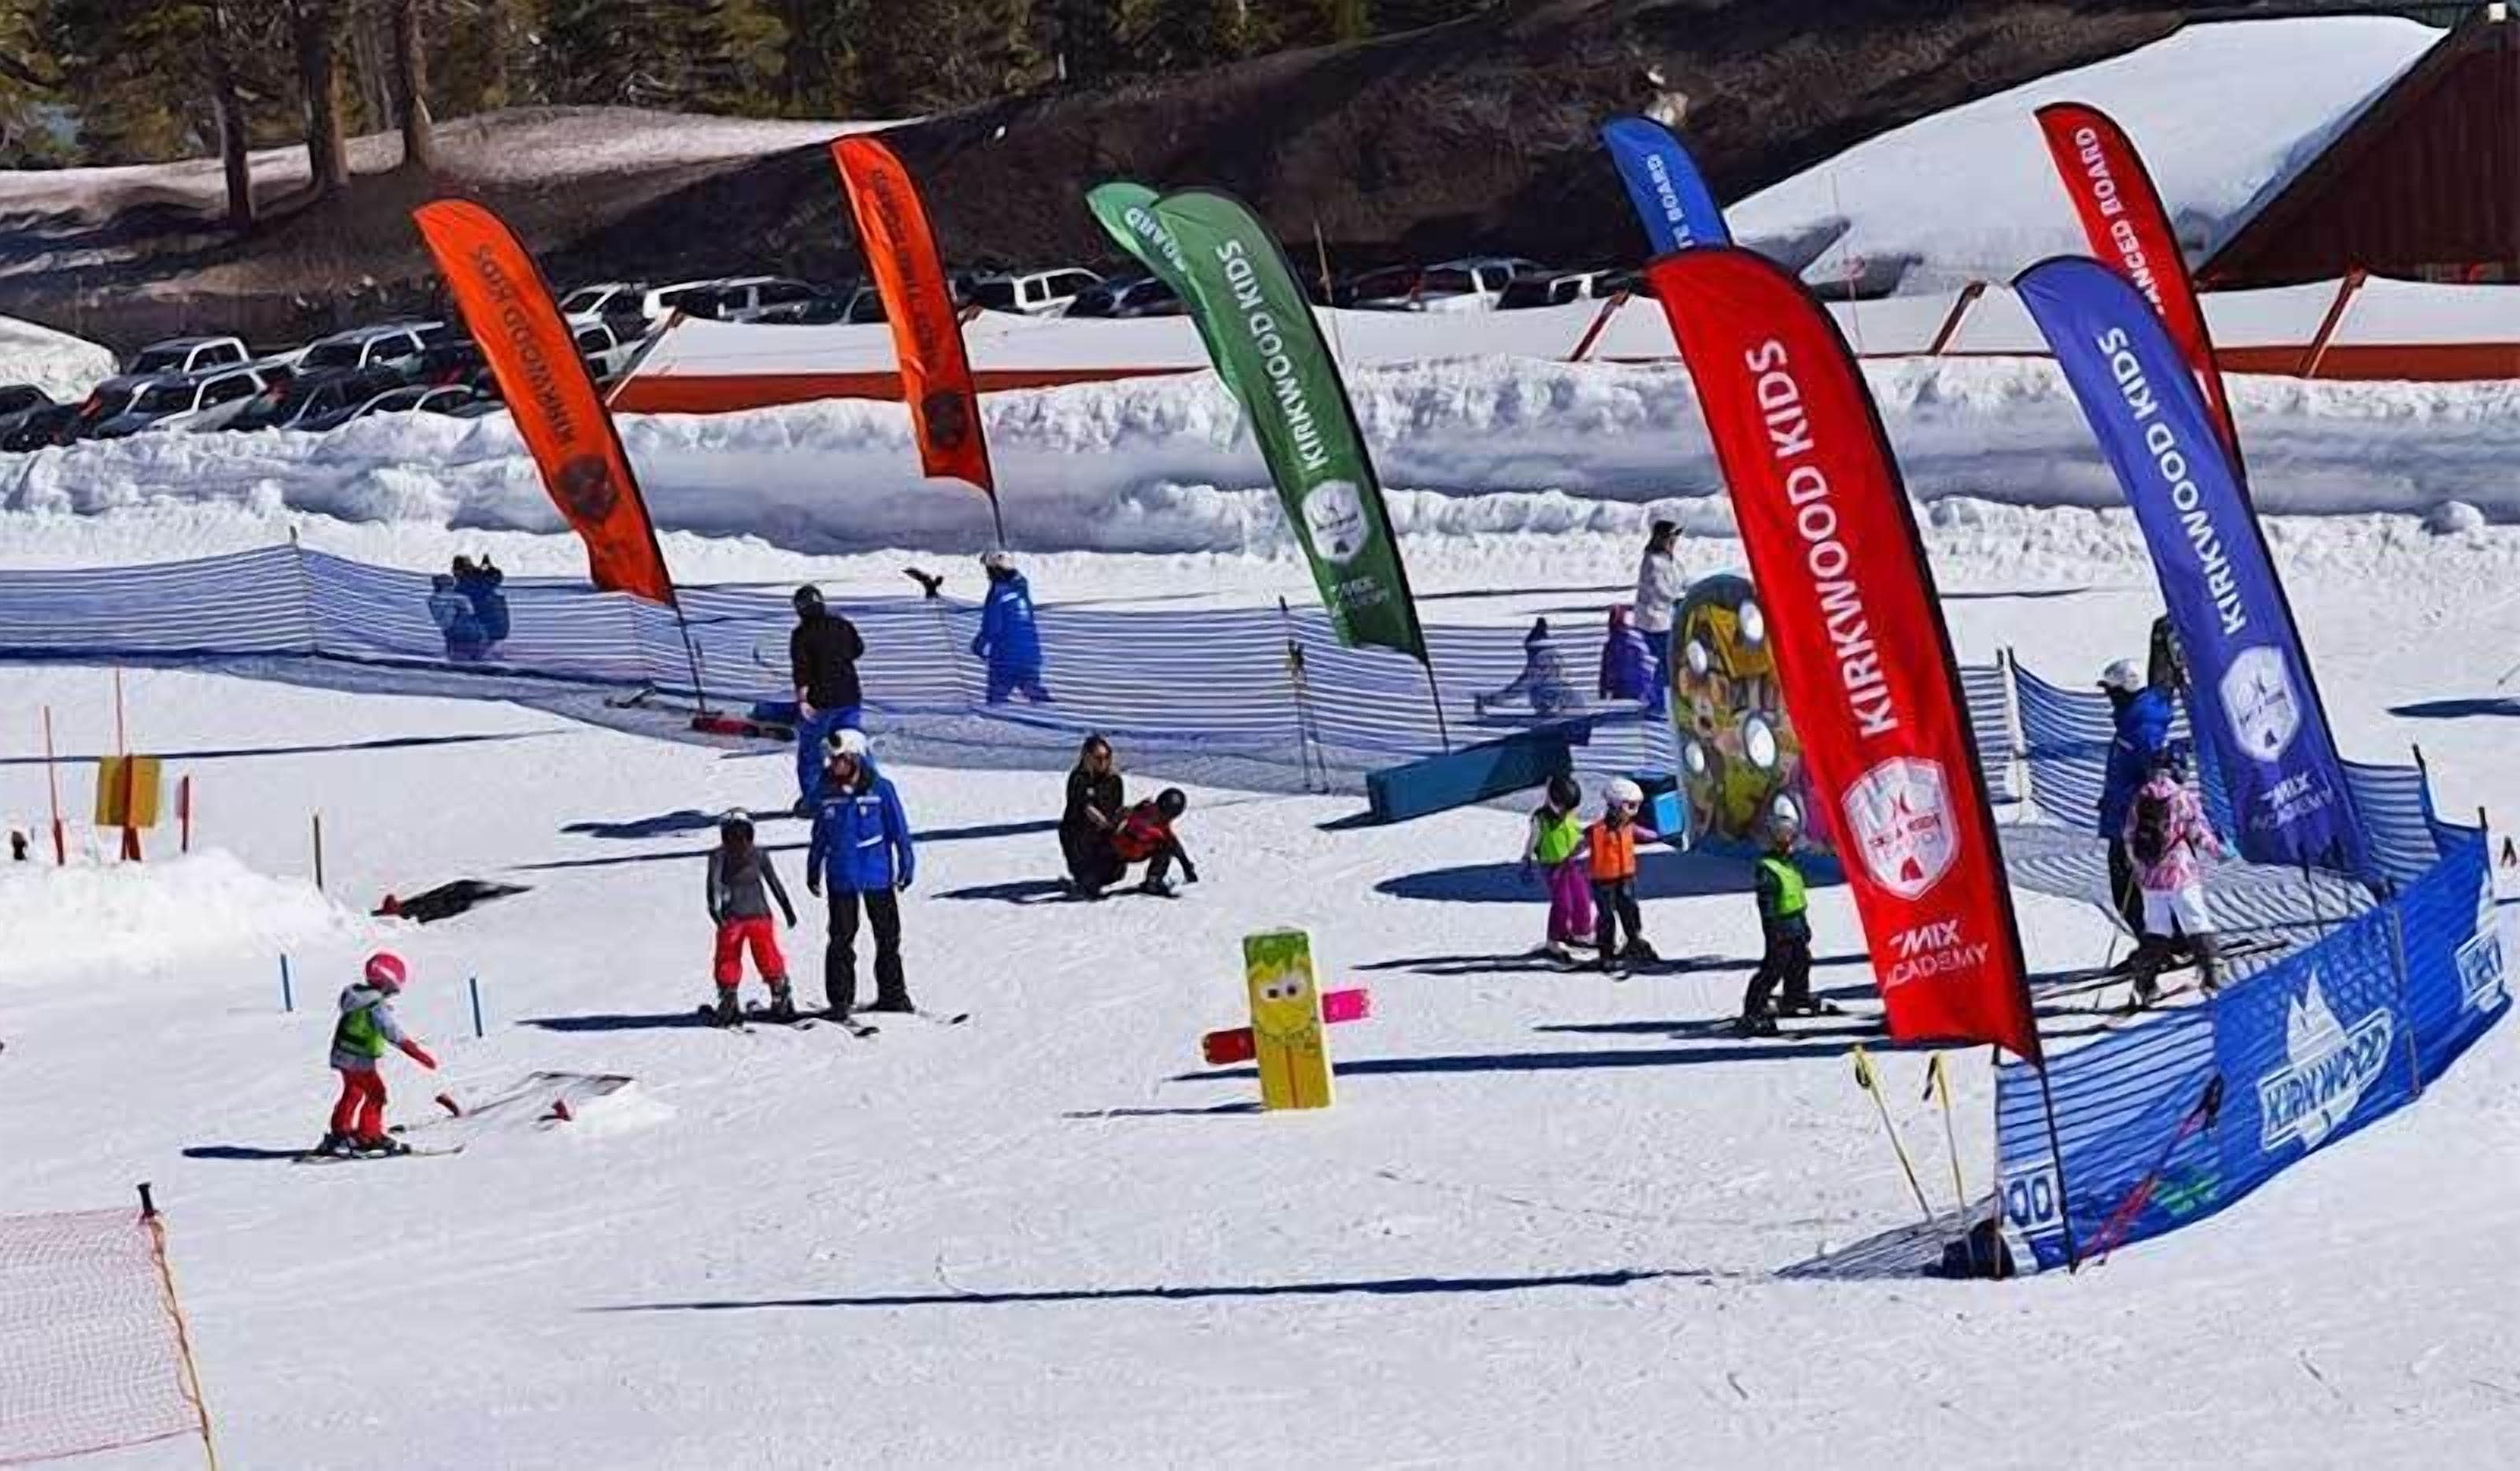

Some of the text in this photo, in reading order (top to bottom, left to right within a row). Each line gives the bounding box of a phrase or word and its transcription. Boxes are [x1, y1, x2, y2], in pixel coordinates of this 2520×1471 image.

[1647, 154, 1684, 222] BOARD
[2075, 128, 2123, 216] BOARD
[1214, 239, 1329, 471] KIRKWOOD KIDS
[1744, 339, 1899, 738] KIRKWOOD KIDS
[2096, 325, 2248, 636] KIRKWOOD KIDS
